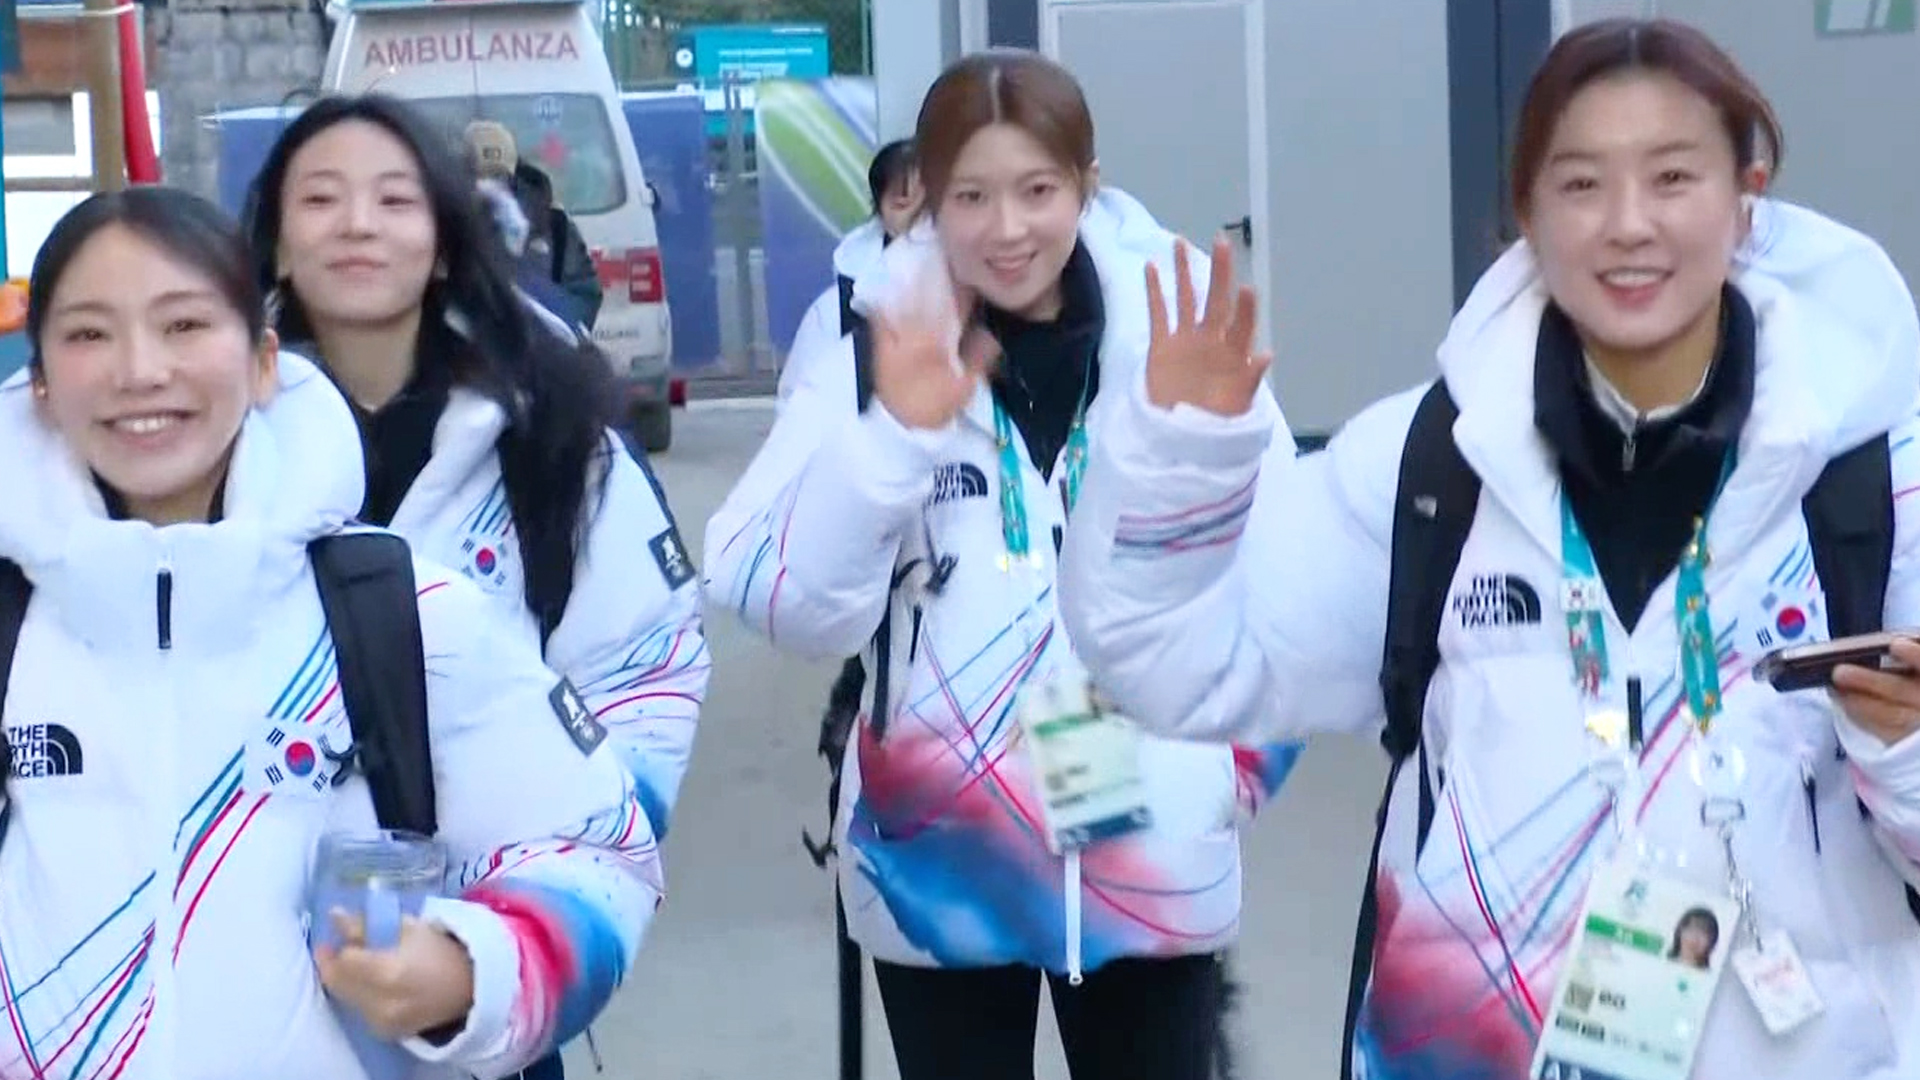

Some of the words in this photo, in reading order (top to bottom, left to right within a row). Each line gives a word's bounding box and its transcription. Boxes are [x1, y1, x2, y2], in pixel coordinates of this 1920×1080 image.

[363, 31, 580, 67] AMBULANZA
[1472, 575, 1504, 595] THE
[1461, 610, 1504, 628] FACE
[9, 724, 44, 743] THE
[9, 741, 44, 760] RTH
